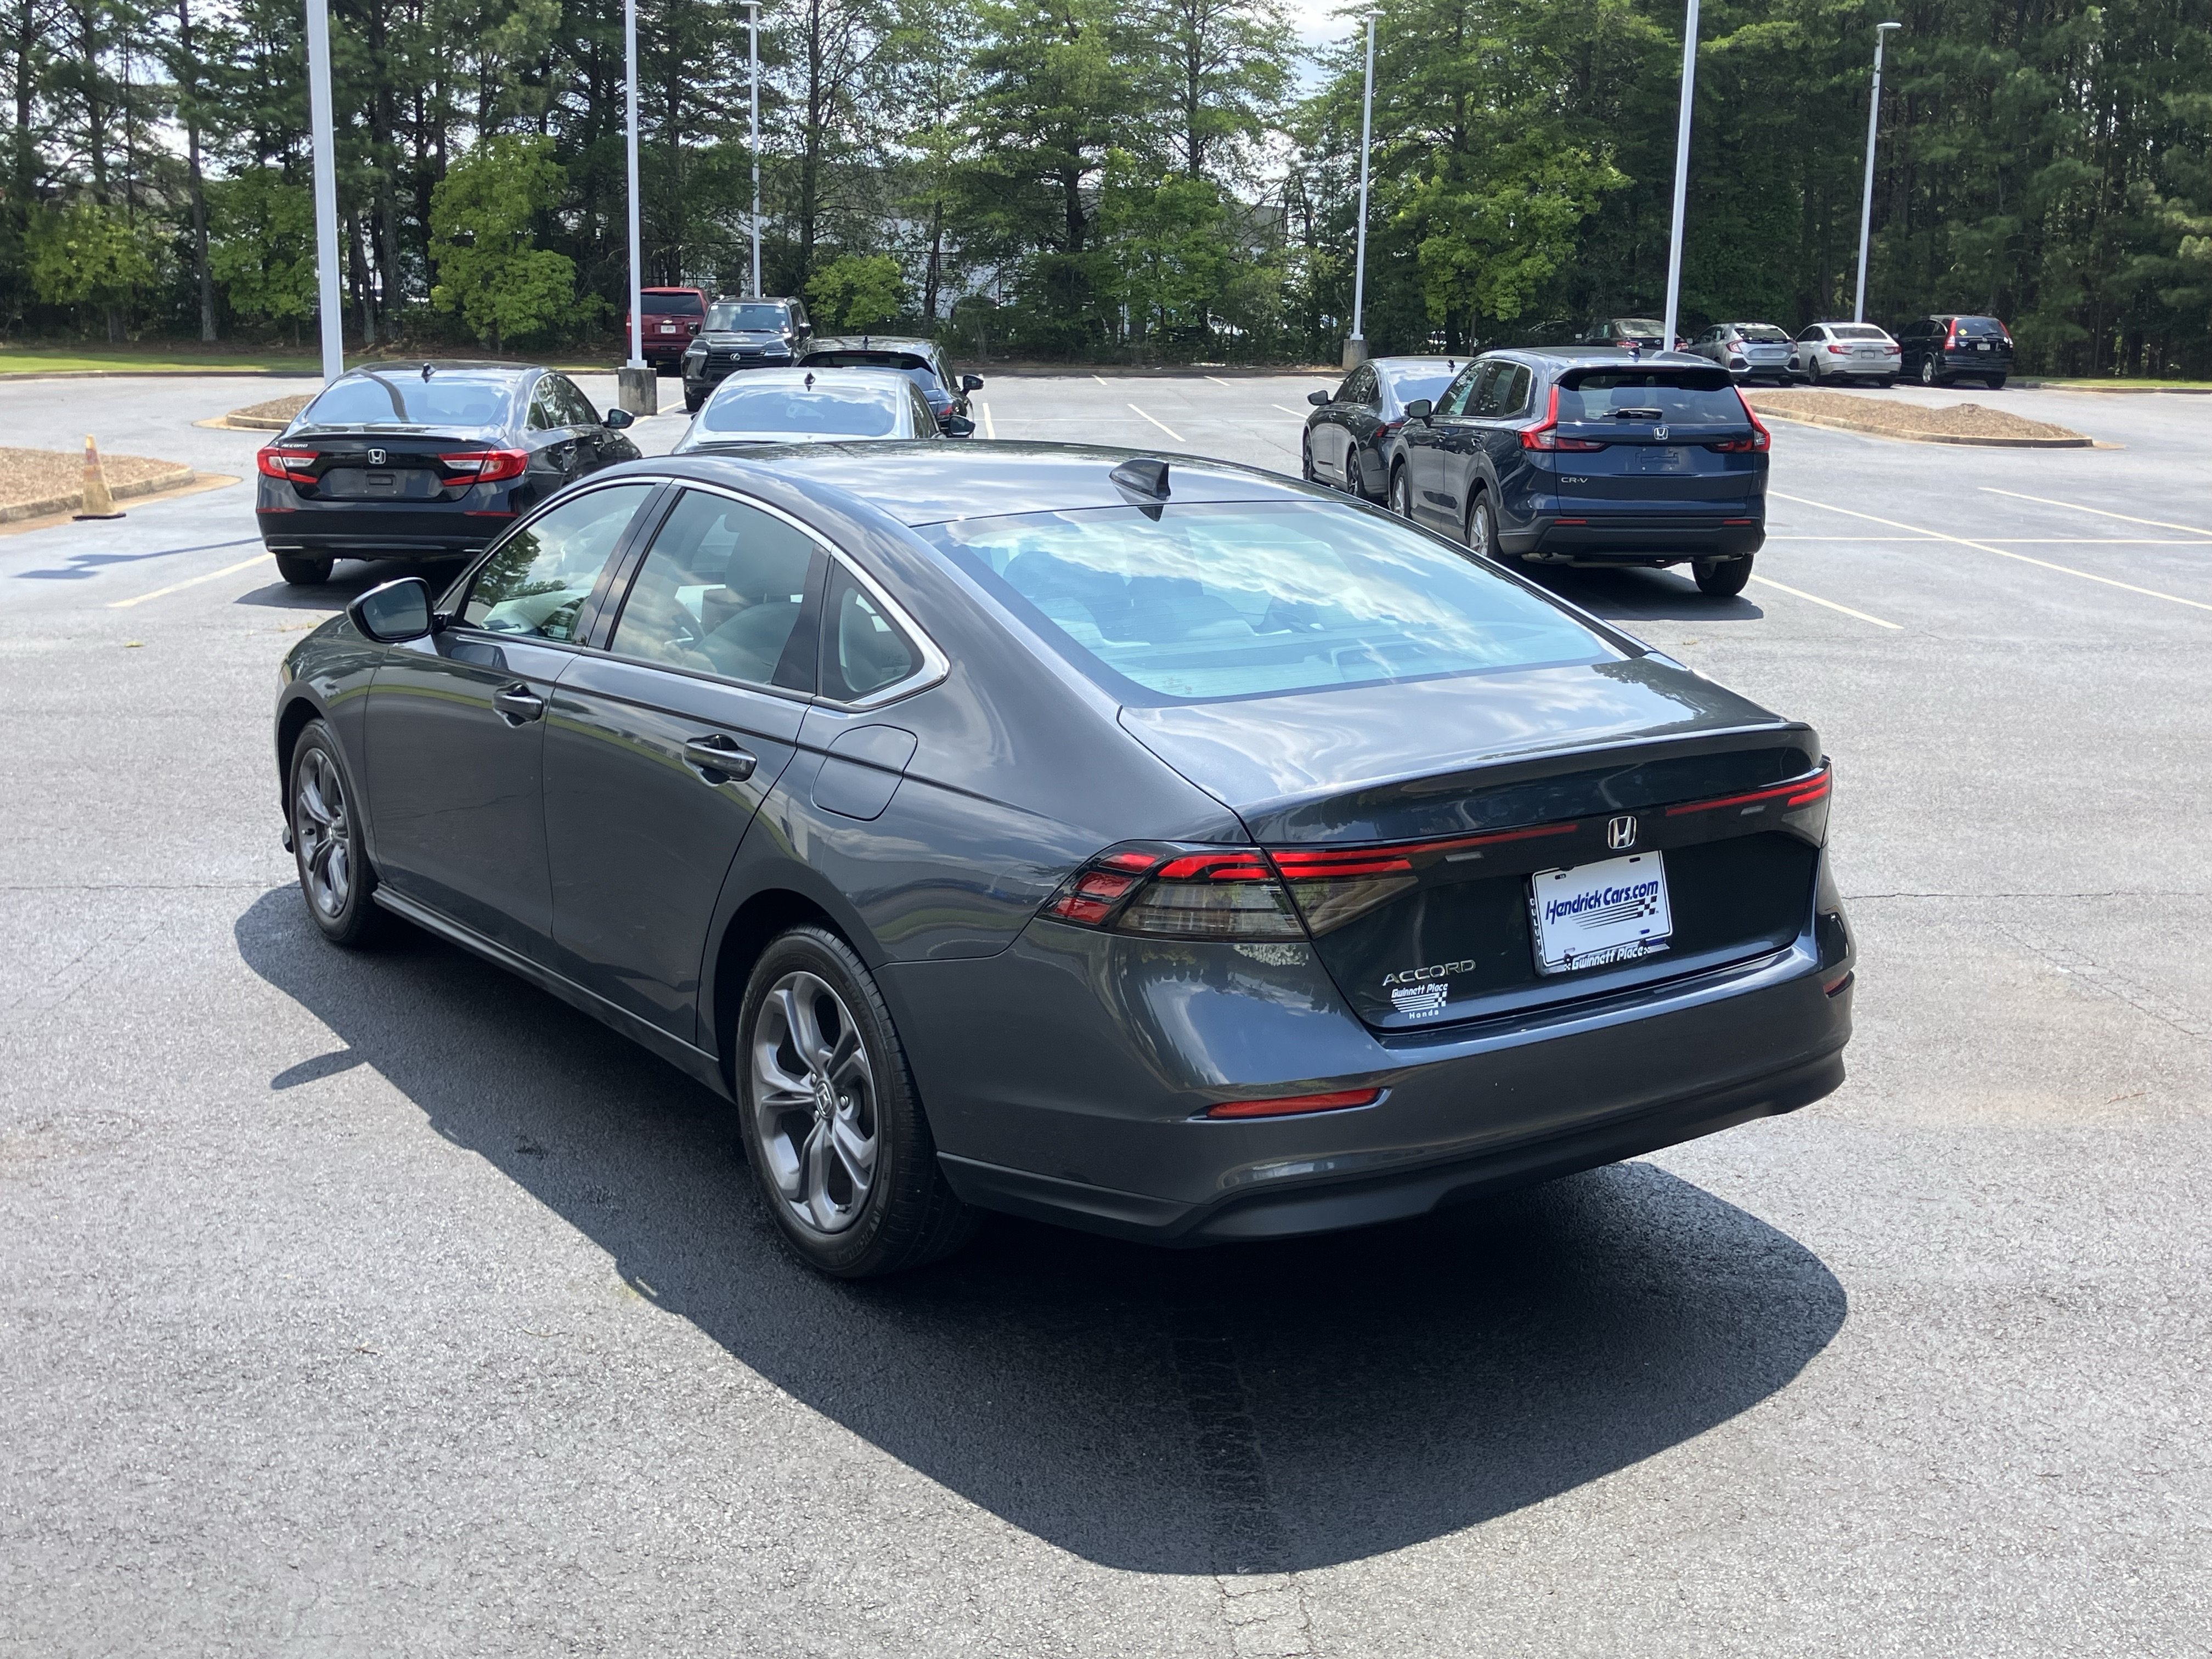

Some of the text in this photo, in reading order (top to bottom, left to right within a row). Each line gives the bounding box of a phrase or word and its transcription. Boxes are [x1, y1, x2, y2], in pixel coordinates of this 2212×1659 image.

[1571, 946, 1644, 970] Gwinnett Place
[1382, 959, 1476, 986] ACCORD
[1391, 983, 1448, 998] Gwinnett Place
[1409, 1009, 1439, 1019] Honda
